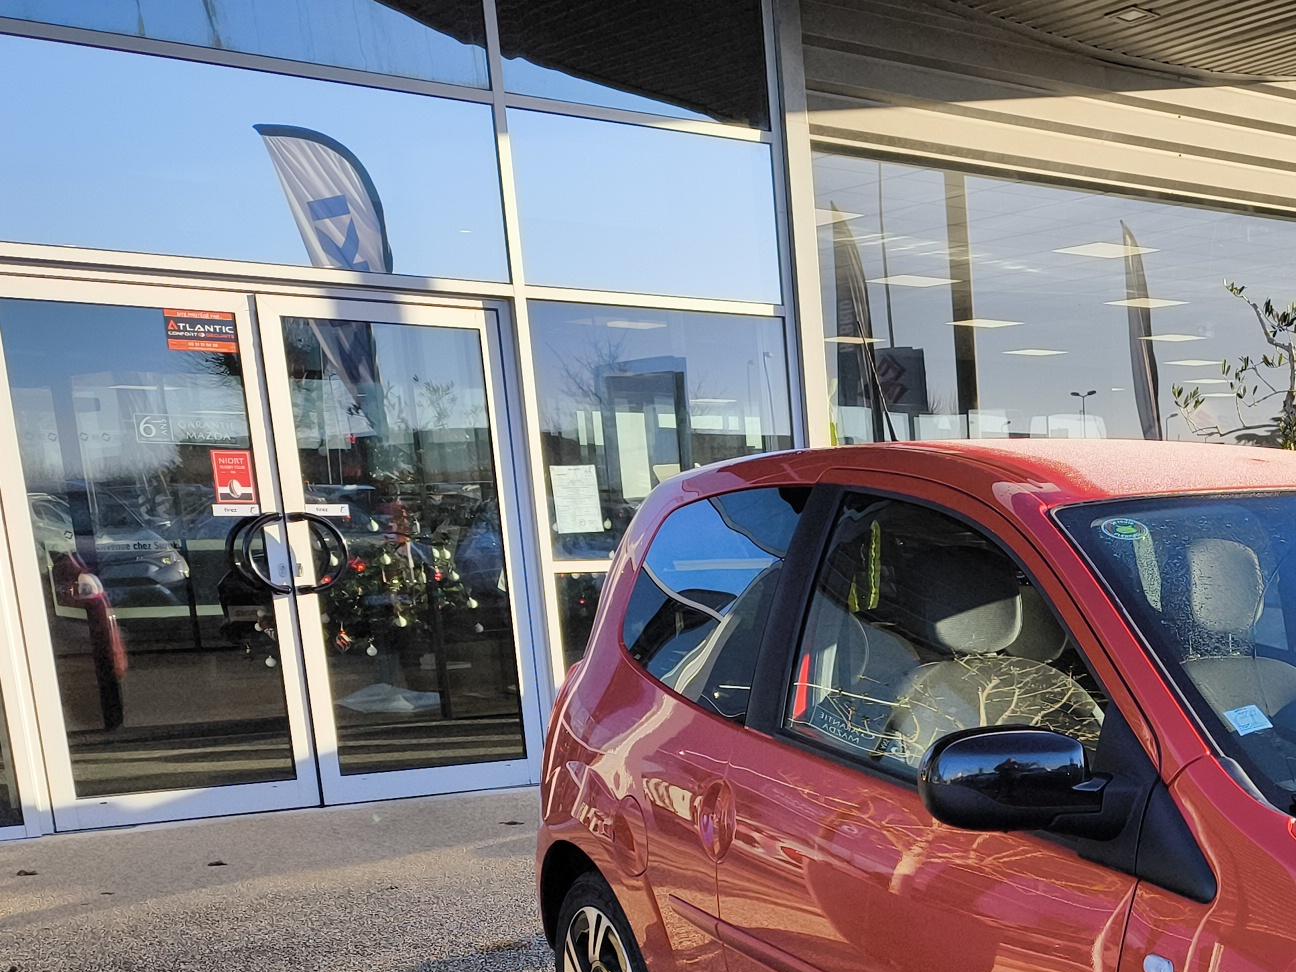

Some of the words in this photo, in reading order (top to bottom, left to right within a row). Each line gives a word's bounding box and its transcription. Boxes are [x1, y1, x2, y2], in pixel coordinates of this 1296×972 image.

[168, 319, 235, 334] ATLANTIC
[139, 416, 156, 438] 6
[186, 431, 231, 441] MAZDA
[218, 457, 244, 465] NIORT
[133, 541, 152, 550] chez
